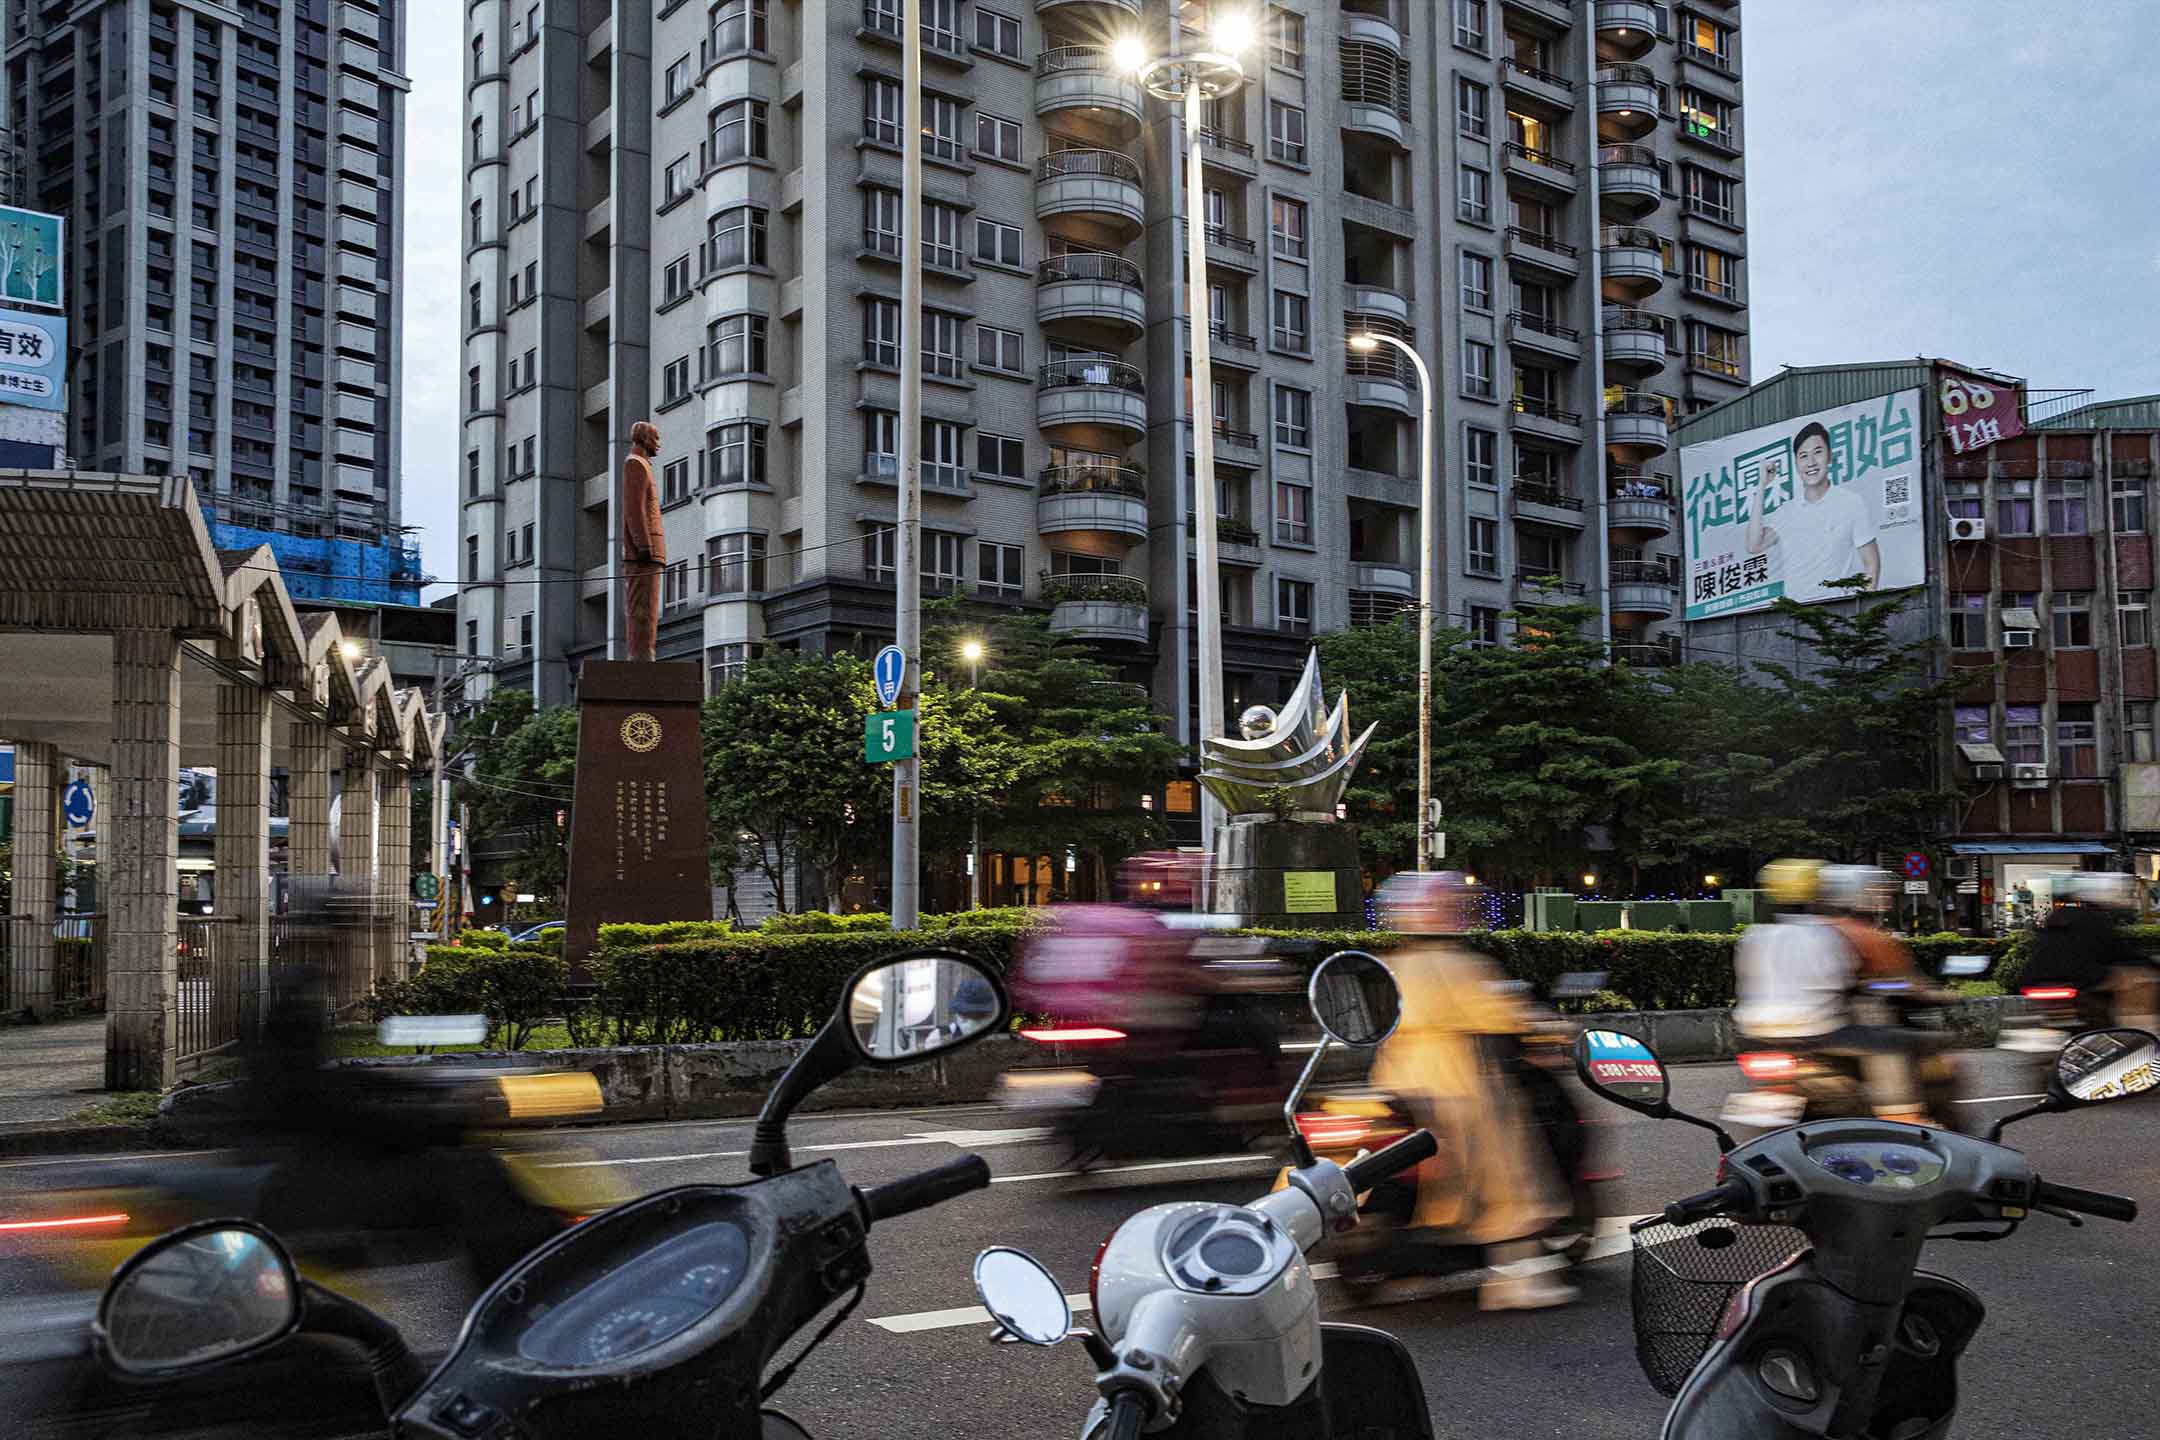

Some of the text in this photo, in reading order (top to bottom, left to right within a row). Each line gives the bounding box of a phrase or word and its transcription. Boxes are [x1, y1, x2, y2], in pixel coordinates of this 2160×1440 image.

[1694, 554, 1768, 603] 陳俊霖
[885, 652, 893, 681] 1
[882, 719, 896, 752] 5
